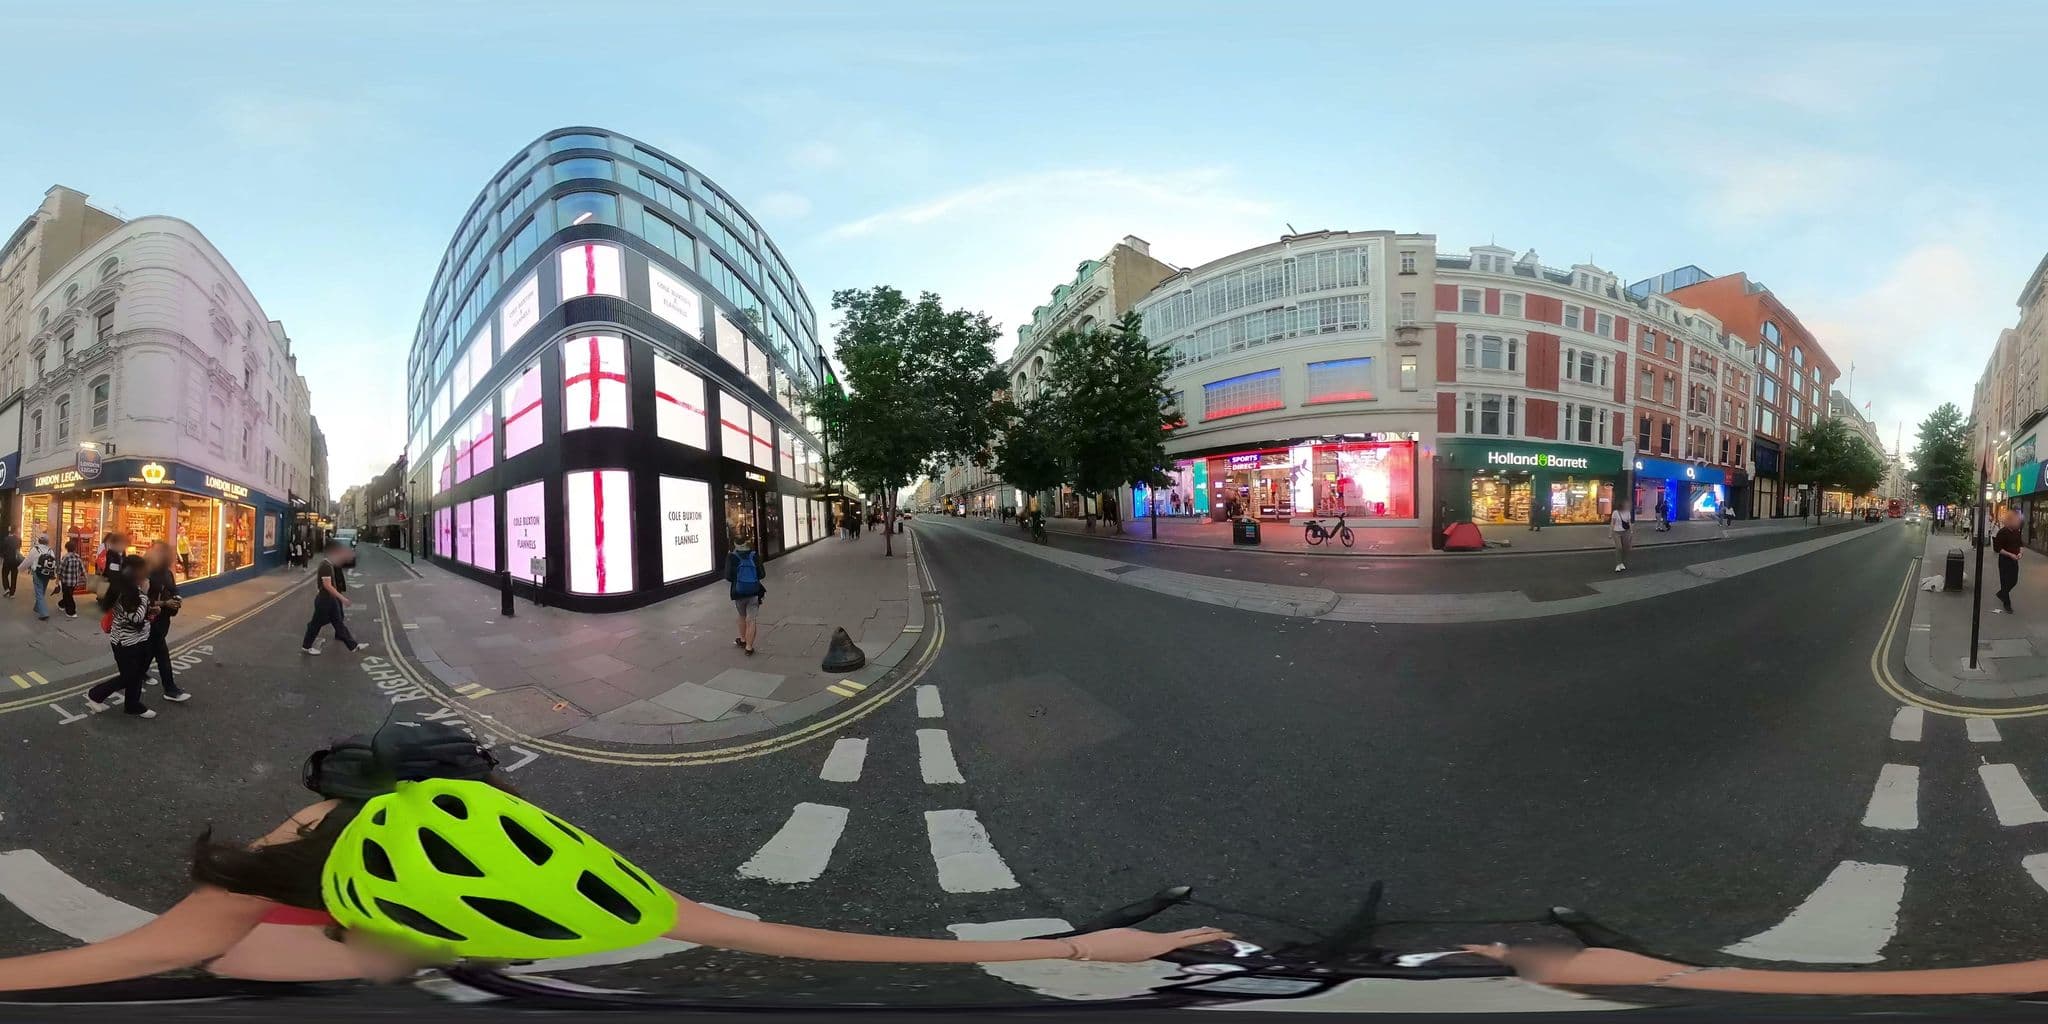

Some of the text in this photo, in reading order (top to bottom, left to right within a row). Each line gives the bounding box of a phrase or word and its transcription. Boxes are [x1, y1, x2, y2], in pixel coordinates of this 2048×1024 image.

[1231, 454, 1258, 463] SPORTS
[1488, 451, 1588, 468] Holland Barrett
[1232, 462, 1258, 470] DIRECT
[35, 473, 60, 488] LONDON
[205, 474, 231, 492] LONDON
[231, 483, 249, 498] LEGACY
[668, 511, 703, 521] COLE BUXTON
[674, 534, 699, 546] FLANNELS
[360, 662, 428, 705] RIGHT
